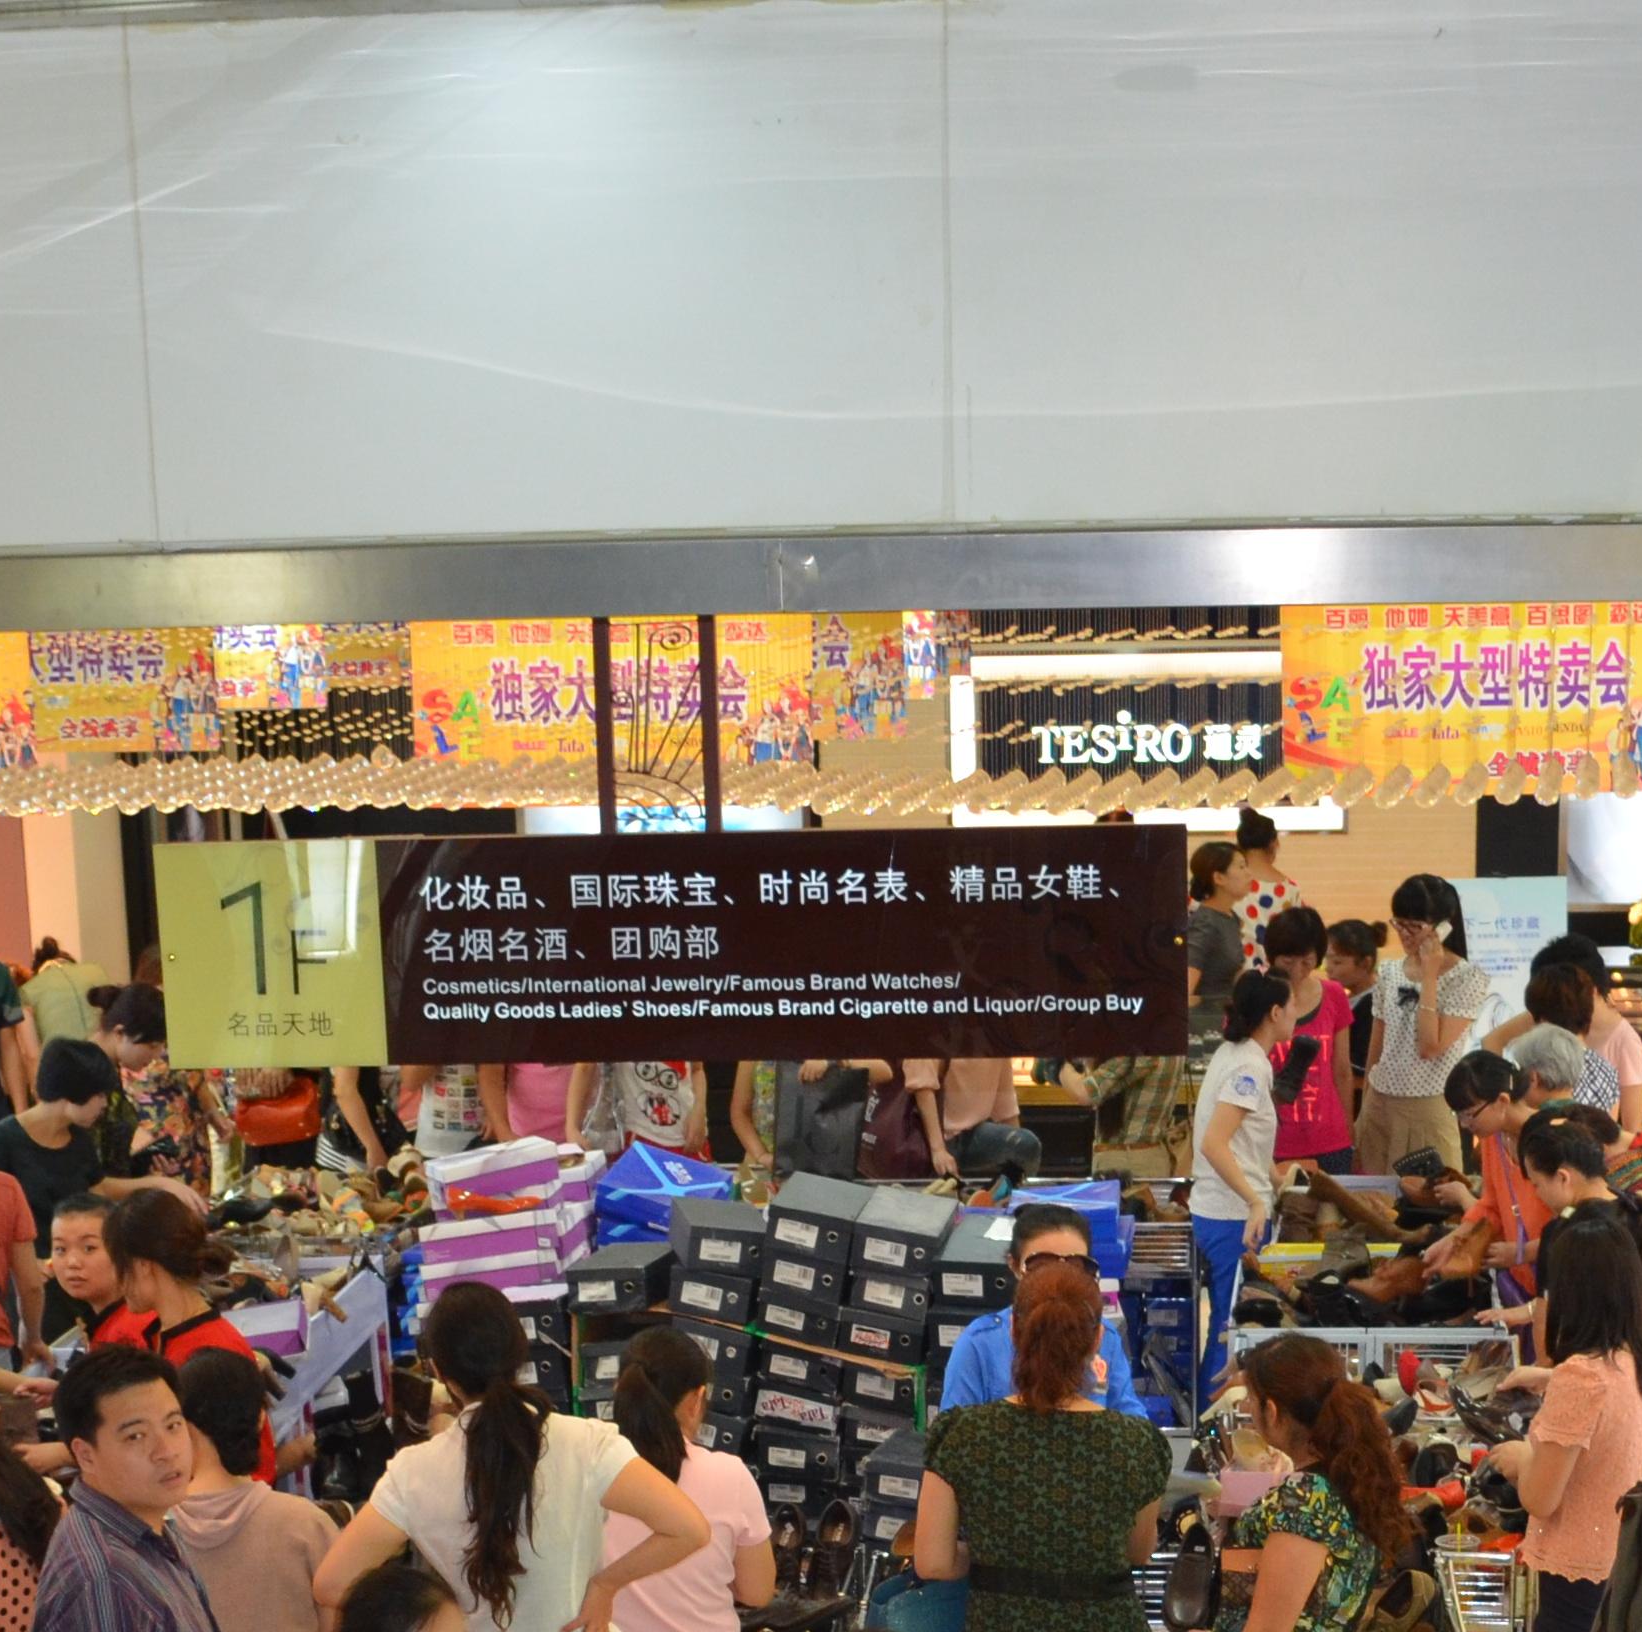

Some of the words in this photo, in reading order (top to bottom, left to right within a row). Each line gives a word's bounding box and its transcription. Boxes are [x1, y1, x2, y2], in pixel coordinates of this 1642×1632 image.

[1363, 641, 1629, 711] 独家大型特卖会
[219, 880, 328, 996] 1F
[423, 925, 721, 963] 名烟名酒、团购部
[423, 977, 647, 995] Cosmetics/International
[651, 974, 806, 995] Jewelry/Famous
[810, 973, 868, 991] Brand
[871, 971, 961, 991] Watches/
[227, 1010, 334, 1038] 名品天地
[423, 1003, 490, 1024] Quality
[494, 1001, 556, 1020] Goods
[632, 998, 774, 1018] Shoes/Famous
[778, 998, 835, 1016] Brand
[839, 997, 929, 1019] Cigarette
[932, 997, 969, 1014] and
[973, 994, 1102, 1017] Liquor/Group
[1106, 994, 1144, 1015] Buy
